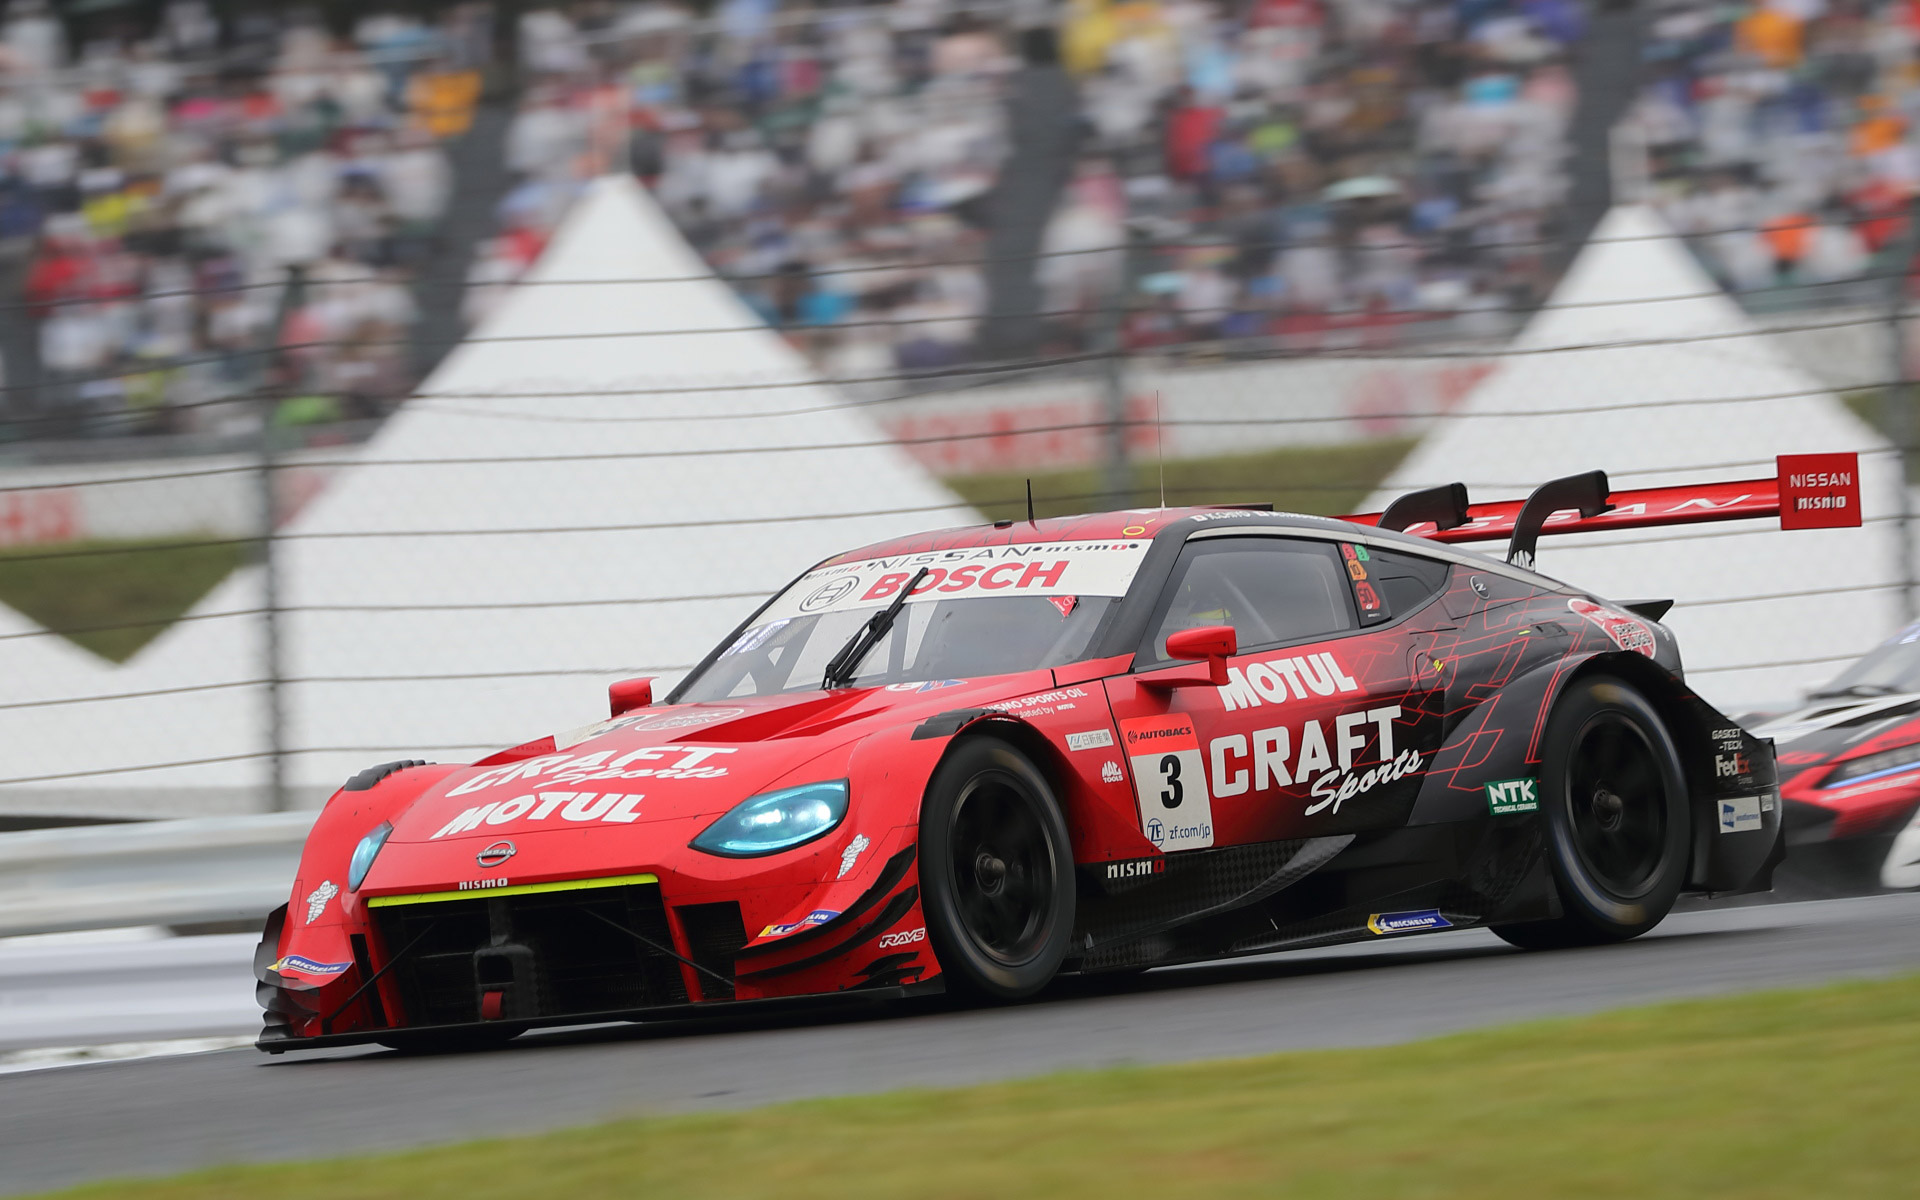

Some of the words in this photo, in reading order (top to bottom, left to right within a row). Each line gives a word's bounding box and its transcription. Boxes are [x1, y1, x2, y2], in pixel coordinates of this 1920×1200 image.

[1790, 472, 1851, 488] NISSAN
[1797, 495, 1847, 510] nismo
[869, 545, 1033, 572] NISSAN
[1045, 544, 1127, 553] nismo
[859, 560, 1071, 602] BOSCH
[1217, 652, 1359, 712] MOTUL
[1020, 690, 1068, 707] SPORTS
[1066, 687, 1089, 698] OIL
[1043, 705, 1055, 716] by
[1056, 703, 1076, 711] MOTUL
[1139, 727, 1191, 741] AUTOBACS
[1712, 728, 1742, 740] GASKET
[1210, 704, 1402, 798] CRAFT
[445, 746, 739, 798] CRAFT
[1101, 760, 1123, 778] MAC
[1715, 752, 1751, 777] FedEx
[533, 765, 729, 789] Sports
[1103, 775, 1123, 784] TOOLS
[1160, 754, 1184, 809] 3
[1305, 749, 1424, 816] Sports
[1488, 779, 1536, 805] NTK
[429, 791, 646, 840] MOTUL
[1493, 804, 1517, 814] TECHNICAL
[1516, 802, 1537, 812] CERAMICS
[1169, 823, 1211, 840] zf.com/jp
[476, 848, 516, 858] NISSAN
[1107, 859, 1166, 879] nismo
[458, 877, 508, 892] nismo
[1389, 916, 1438, 929] MICHELIN
[879, 927, 926, 949] RAYS
[289, 958, 341, 973] MICHELIN
